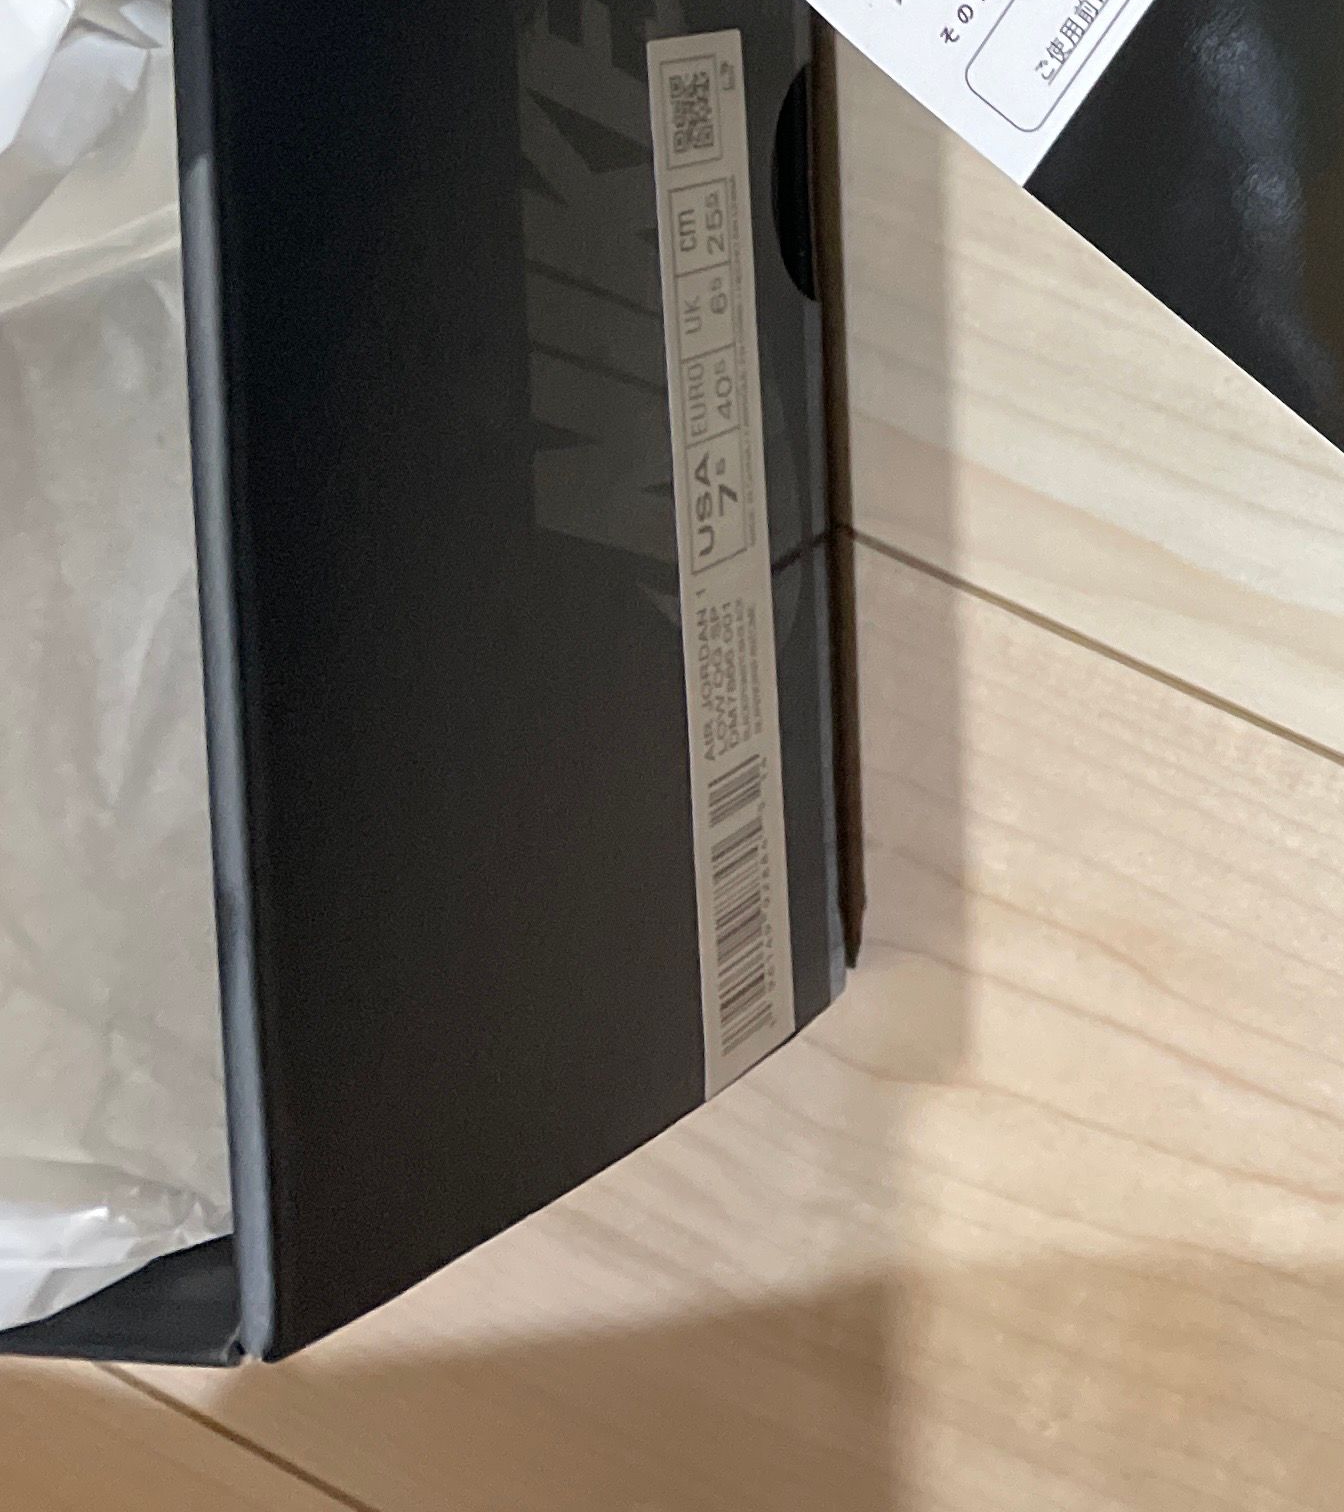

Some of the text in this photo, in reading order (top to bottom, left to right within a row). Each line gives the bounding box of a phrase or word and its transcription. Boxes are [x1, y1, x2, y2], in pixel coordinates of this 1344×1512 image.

[684, 295, 702, 333] UK
[688, 361, 707, 436] EURO
[694, 450, 714, 556] USA
[696, 607, 712, 708] JORDAN
[714, 694, 728, 755] LOW
